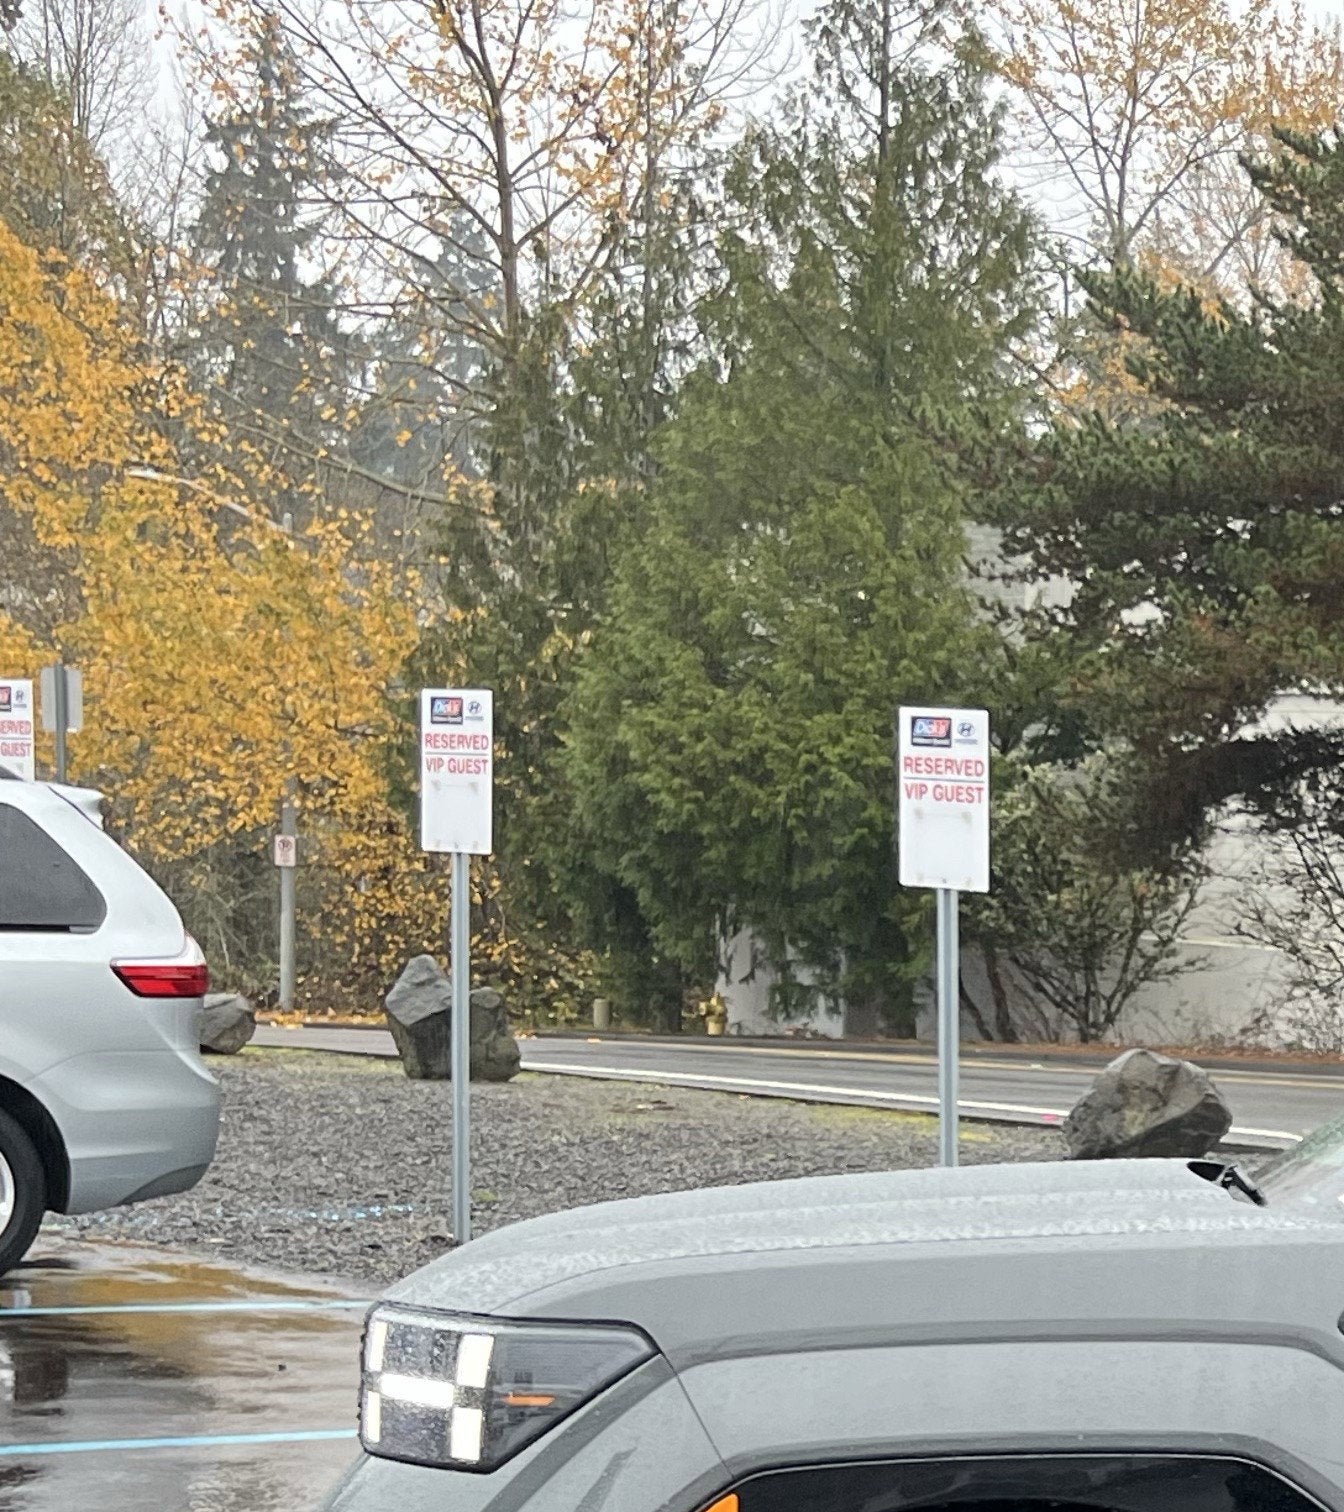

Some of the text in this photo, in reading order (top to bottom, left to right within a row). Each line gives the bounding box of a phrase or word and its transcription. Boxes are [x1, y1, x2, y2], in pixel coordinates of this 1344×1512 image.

[424, 732, 489, 751] RESERVED
[425, 757, 489, 775] VIP GUEST
[903, 756, 985, 778] RESERVED
[904, 782, 985, 804] VIP GUEST
